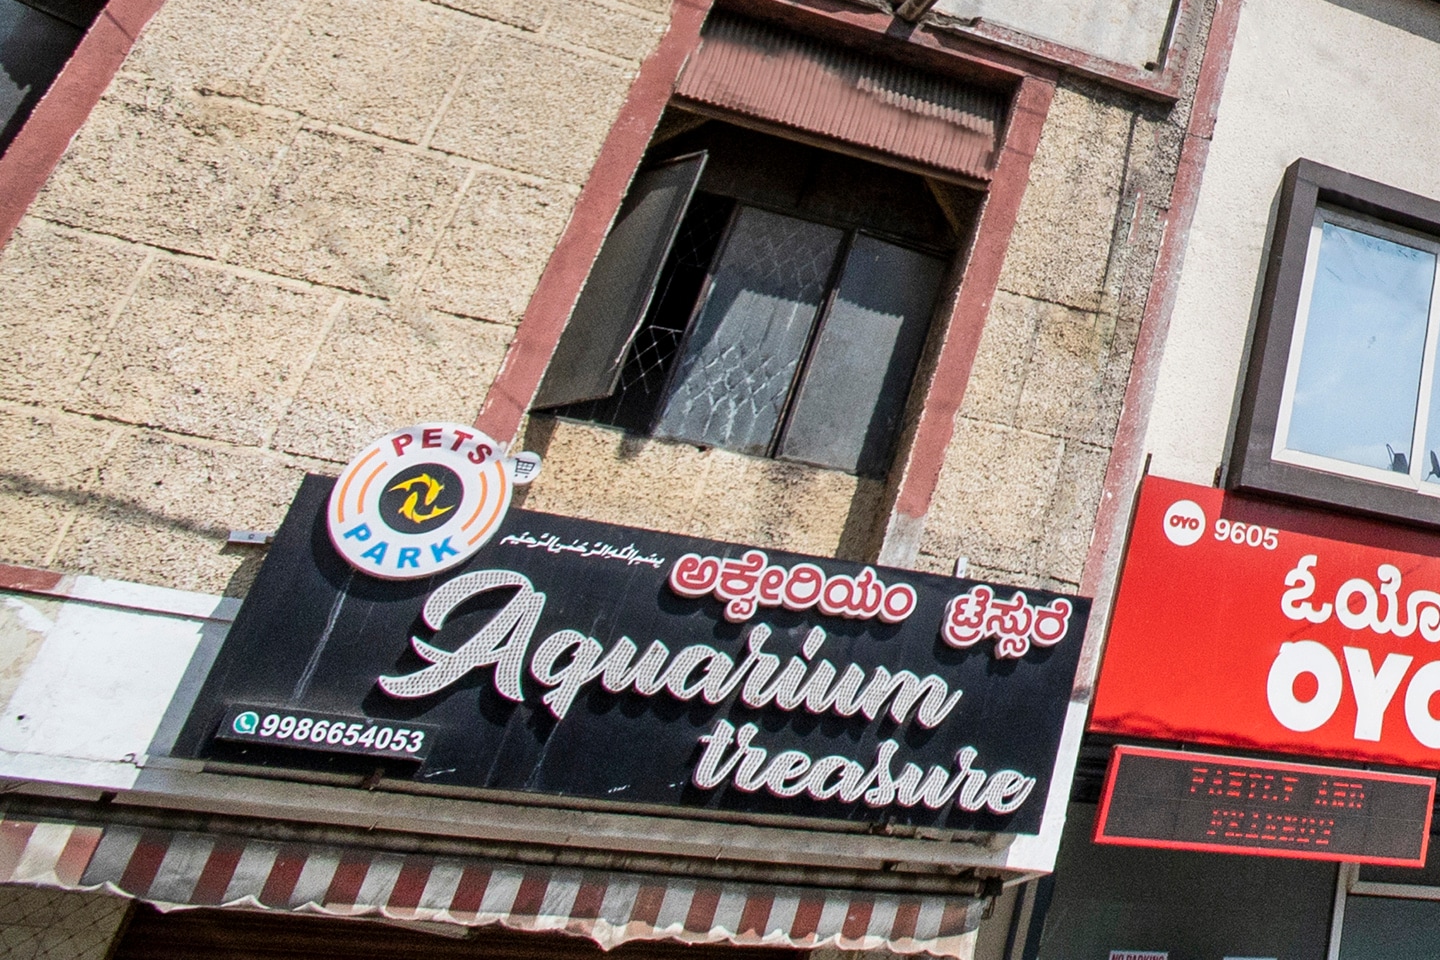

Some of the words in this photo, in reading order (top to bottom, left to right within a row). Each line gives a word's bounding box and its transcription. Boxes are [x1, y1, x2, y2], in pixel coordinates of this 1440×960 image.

[391, 428, 493, 465] PETS
[342, 522, 461, 569] PARK
[1170, 515, 1199, 530] OYO
[1214, 519, 1279, 550] 9605
[378, 569, 963, 729] Aquarium
[260, 714, 425, 752] 9986654053
[691, 719, 1035, 815] treasure
